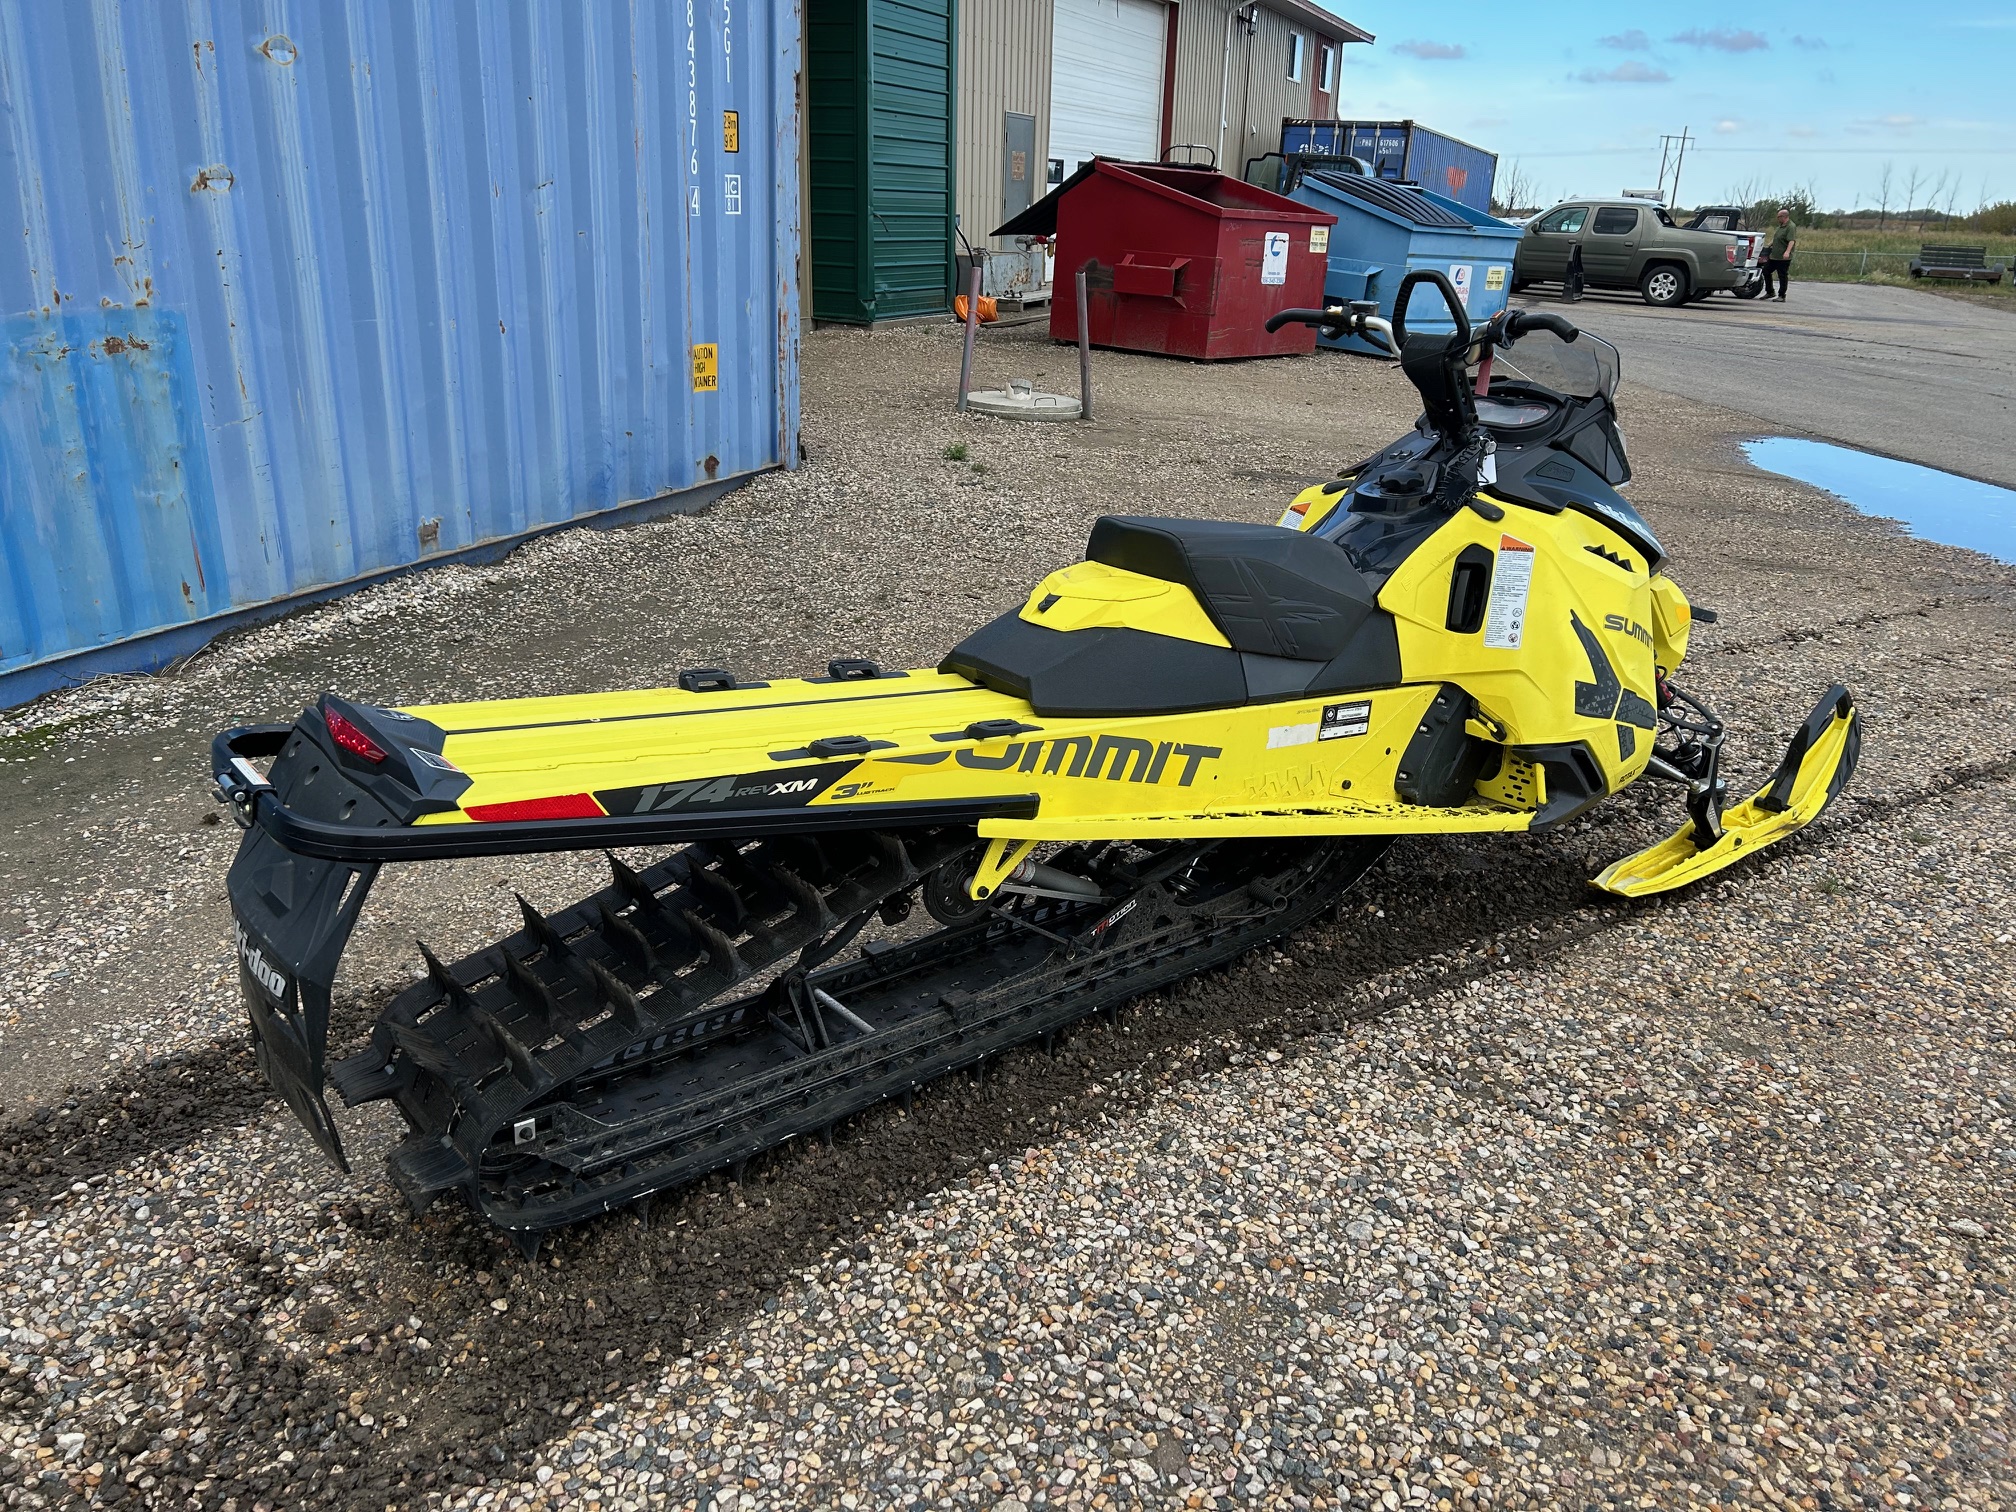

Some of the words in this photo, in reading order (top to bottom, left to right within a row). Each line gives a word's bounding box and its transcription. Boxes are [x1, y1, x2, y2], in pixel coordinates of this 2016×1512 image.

[694, 347, 713, 360] AUTION
[694, 362, 706, 373] HIGH
[632, 777, 738, 814] 174
